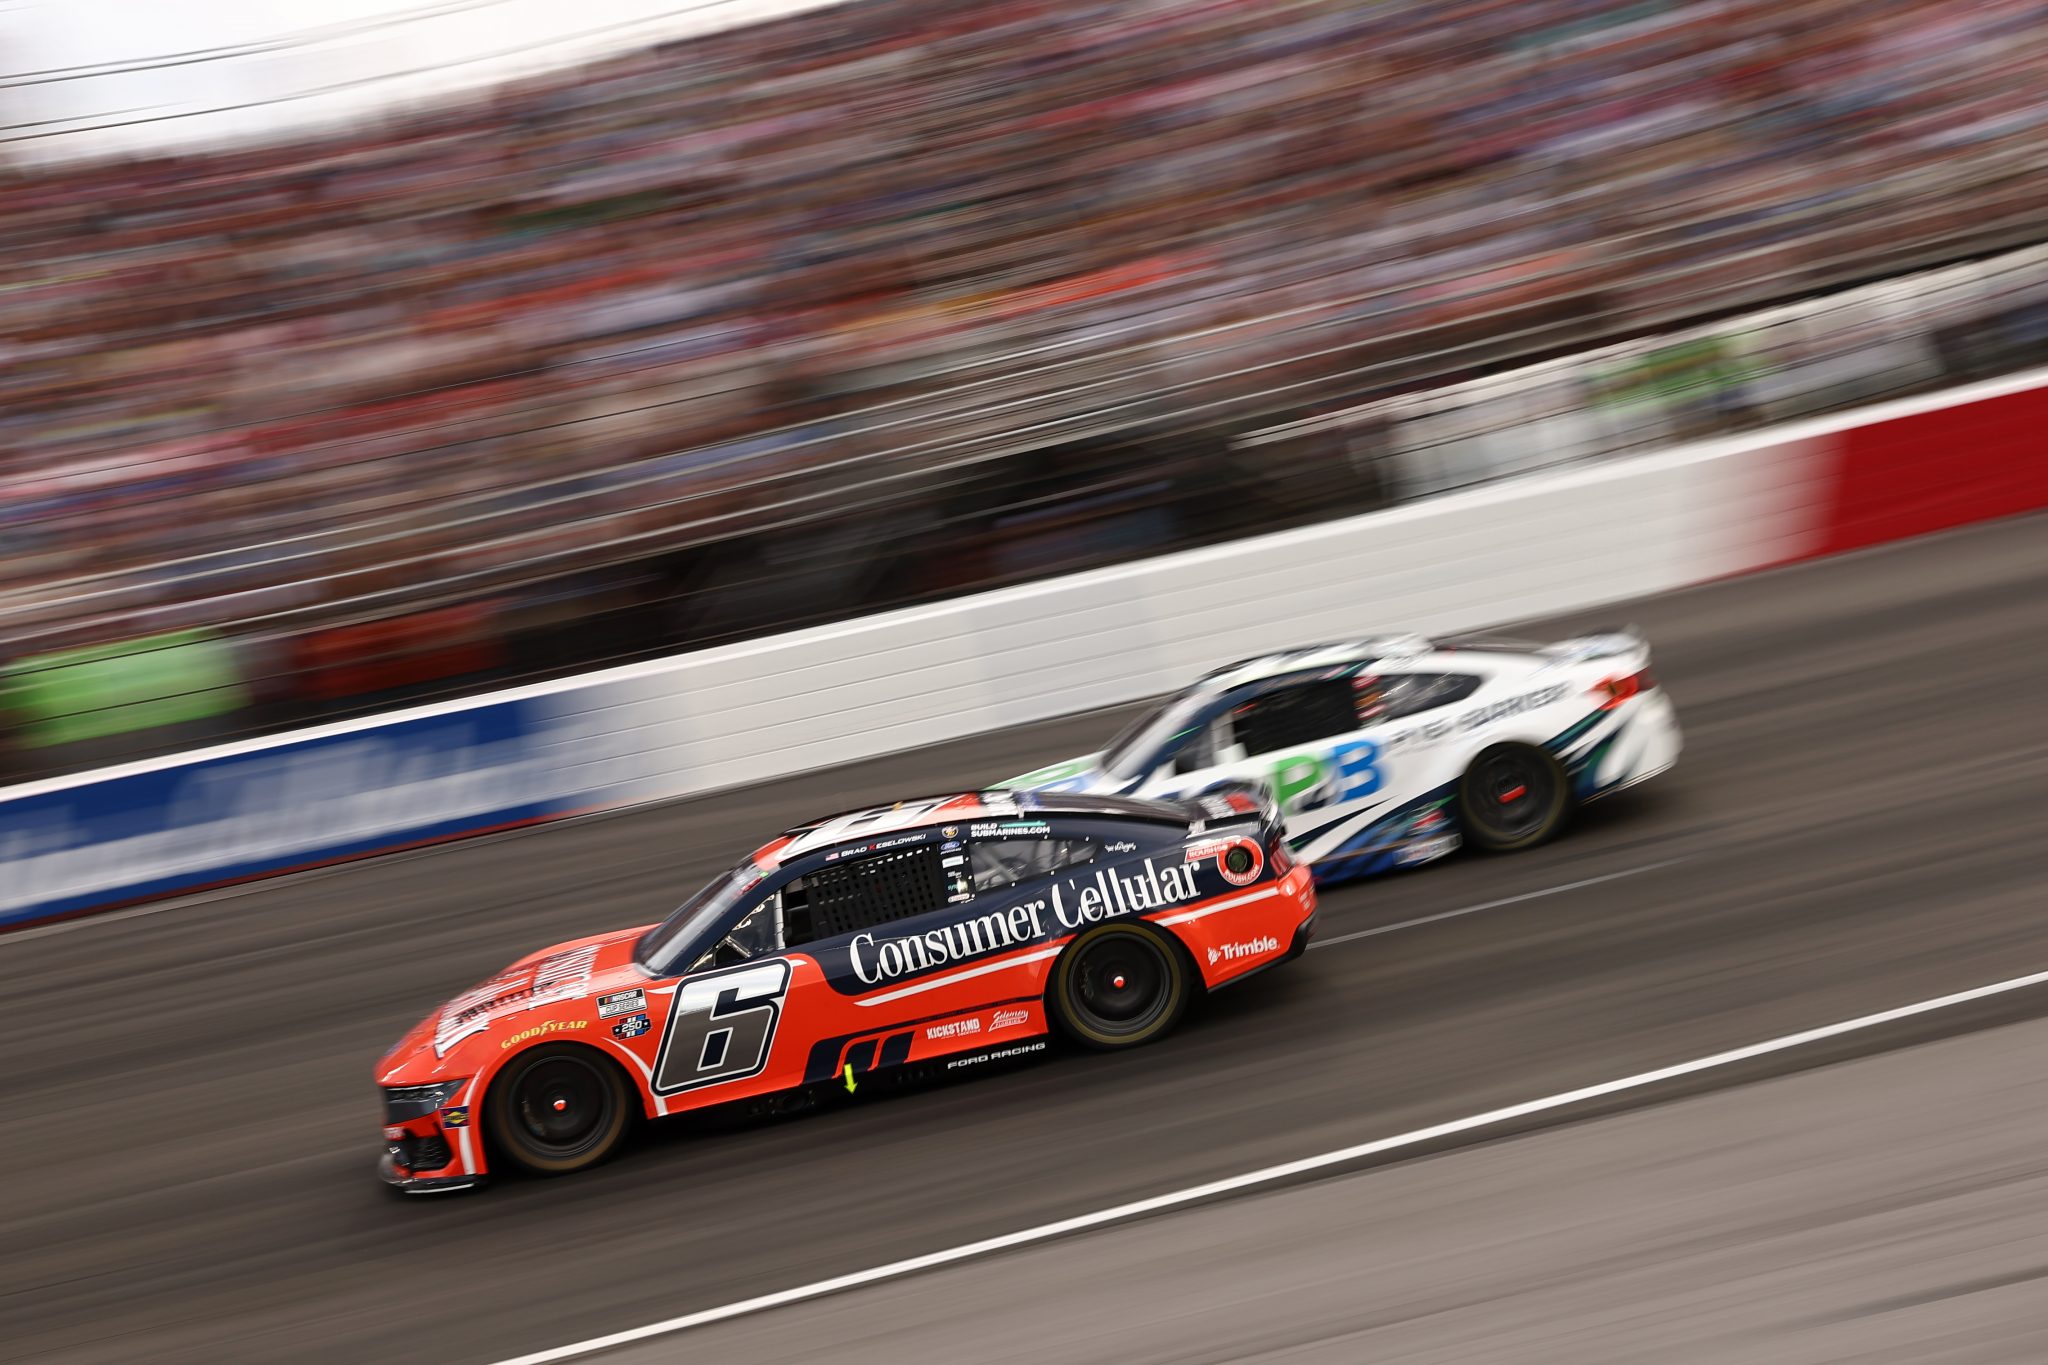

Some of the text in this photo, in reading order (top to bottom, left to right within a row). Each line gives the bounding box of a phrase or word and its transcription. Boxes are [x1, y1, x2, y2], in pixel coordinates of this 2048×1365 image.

[970, 822, 998, 831] BUILD
[970, 826, 1051, 837] SUBMARINES.COM
[841, 846, 868, 857] BRAD
[868, 833, 927, 851] KESELOWSKI
[850, 858, 1201, 984] Consumer Cellular
[1220, 935, 1278, 960] Trimble
[605, 999, 639, 1013] CUP SERIES
[611, 990, 638, 1003] NASCAR
[500, 1020, 588, 1050] GOODYEAR
[621, 1020, 643, 1033] 250
[649, 957, 793, 1098] 6
[926, 1018, 980, 1040] KICKSTAND
[947, 1041, 1046, 1070] FORD RACING
